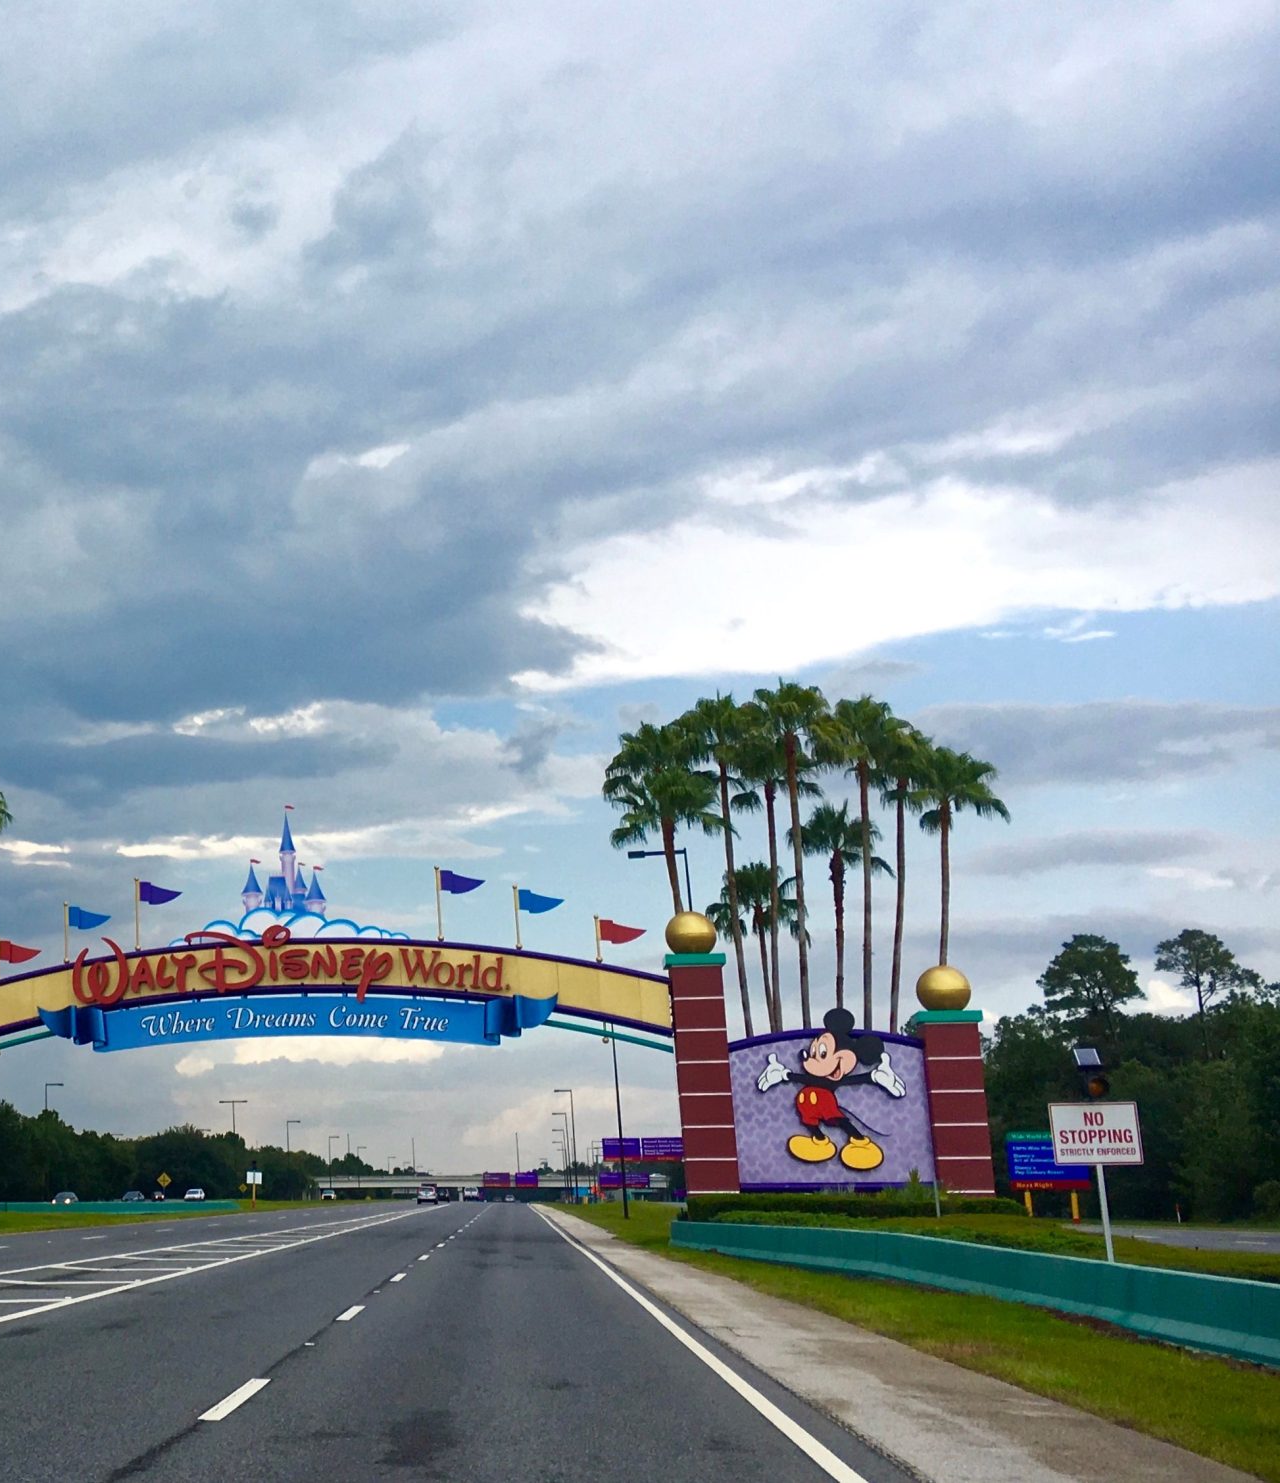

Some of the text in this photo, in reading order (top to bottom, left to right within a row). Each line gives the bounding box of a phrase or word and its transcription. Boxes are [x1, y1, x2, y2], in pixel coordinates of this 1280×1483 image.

[141, 1005, 448, 1037] Where Dreams Come True
[1083, 1111, 1104, 1126] NO
[1059, 1129, 1133, 1144] STOPPING
[1060, 1147, 1136, 1156] STRICTLY ENFORCED
